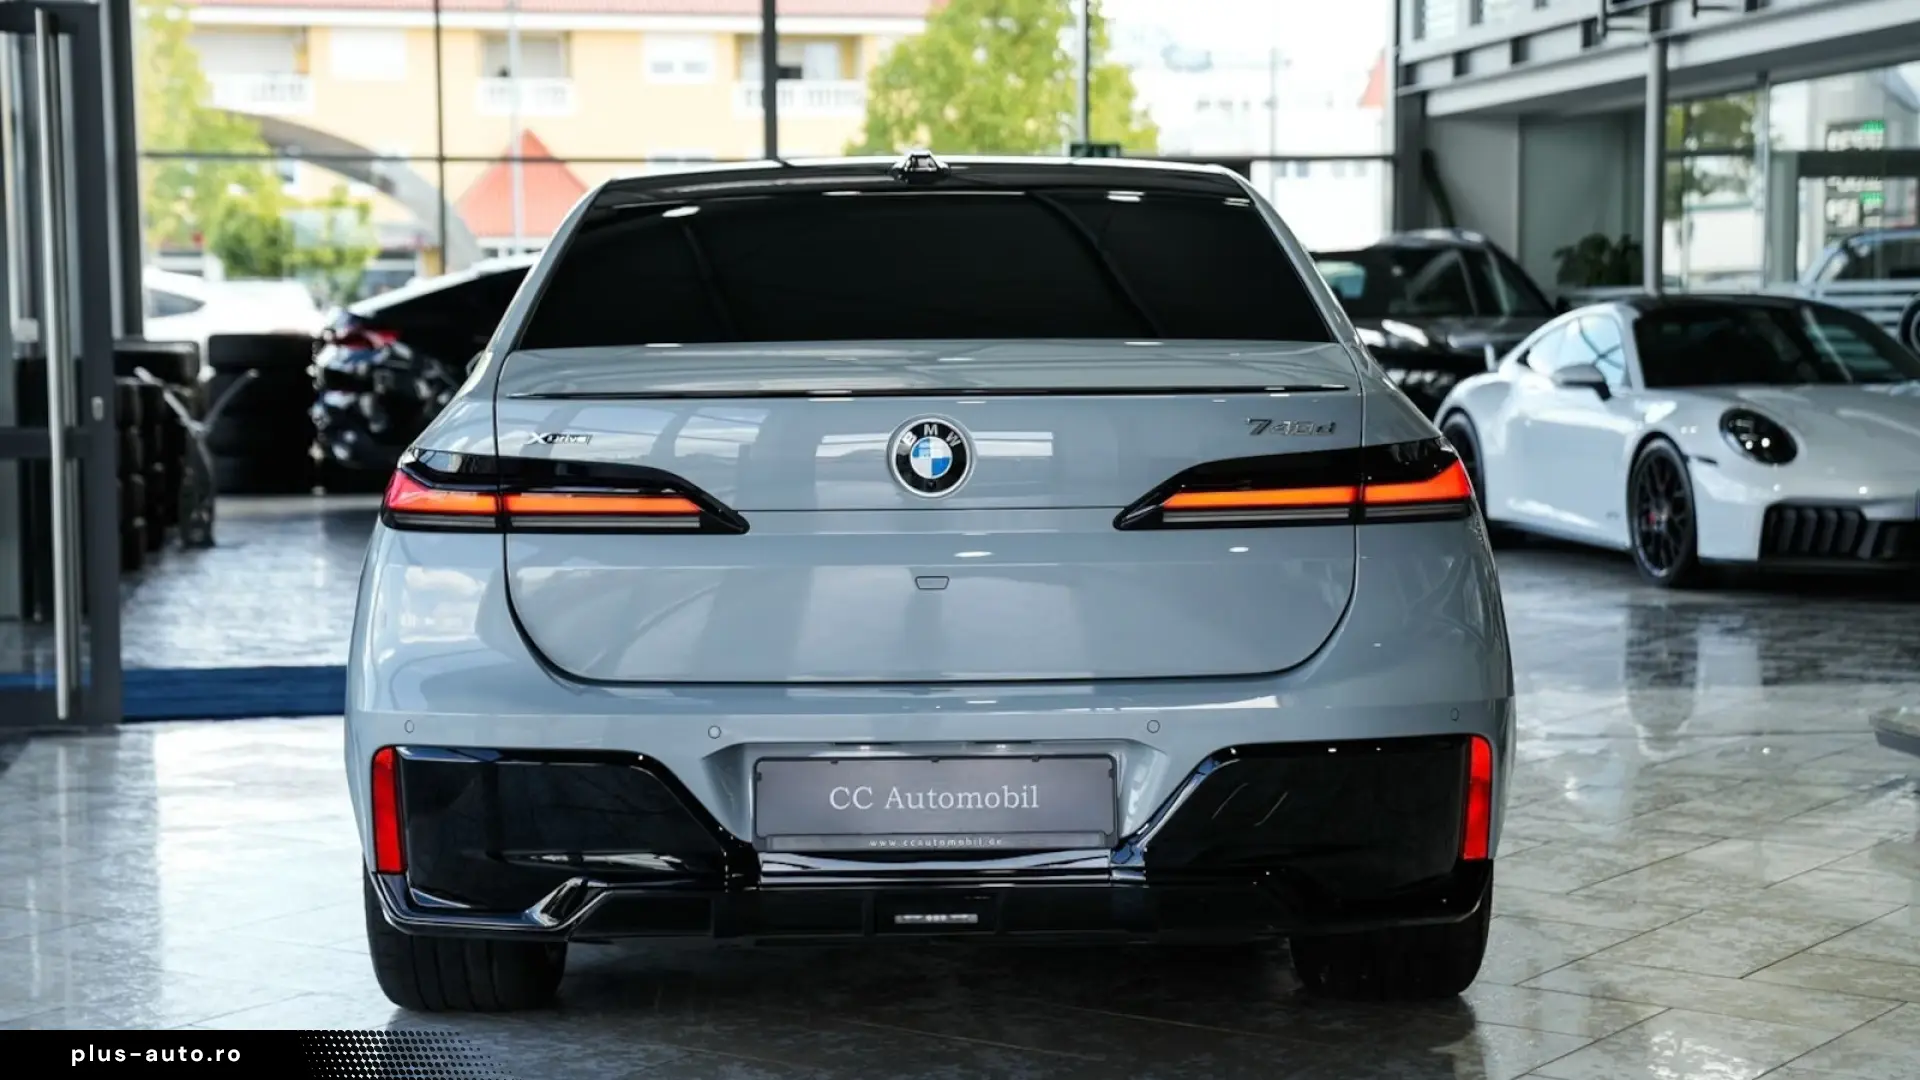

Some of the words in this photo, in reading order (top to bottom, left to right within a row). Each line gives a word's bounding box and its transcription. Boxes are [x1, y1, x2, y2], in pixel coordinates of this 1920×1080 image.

[900, 423, 963, 447] BMW
[829, 786, 874, 810] CC
[884, 784, 1040, 810] Automobil
